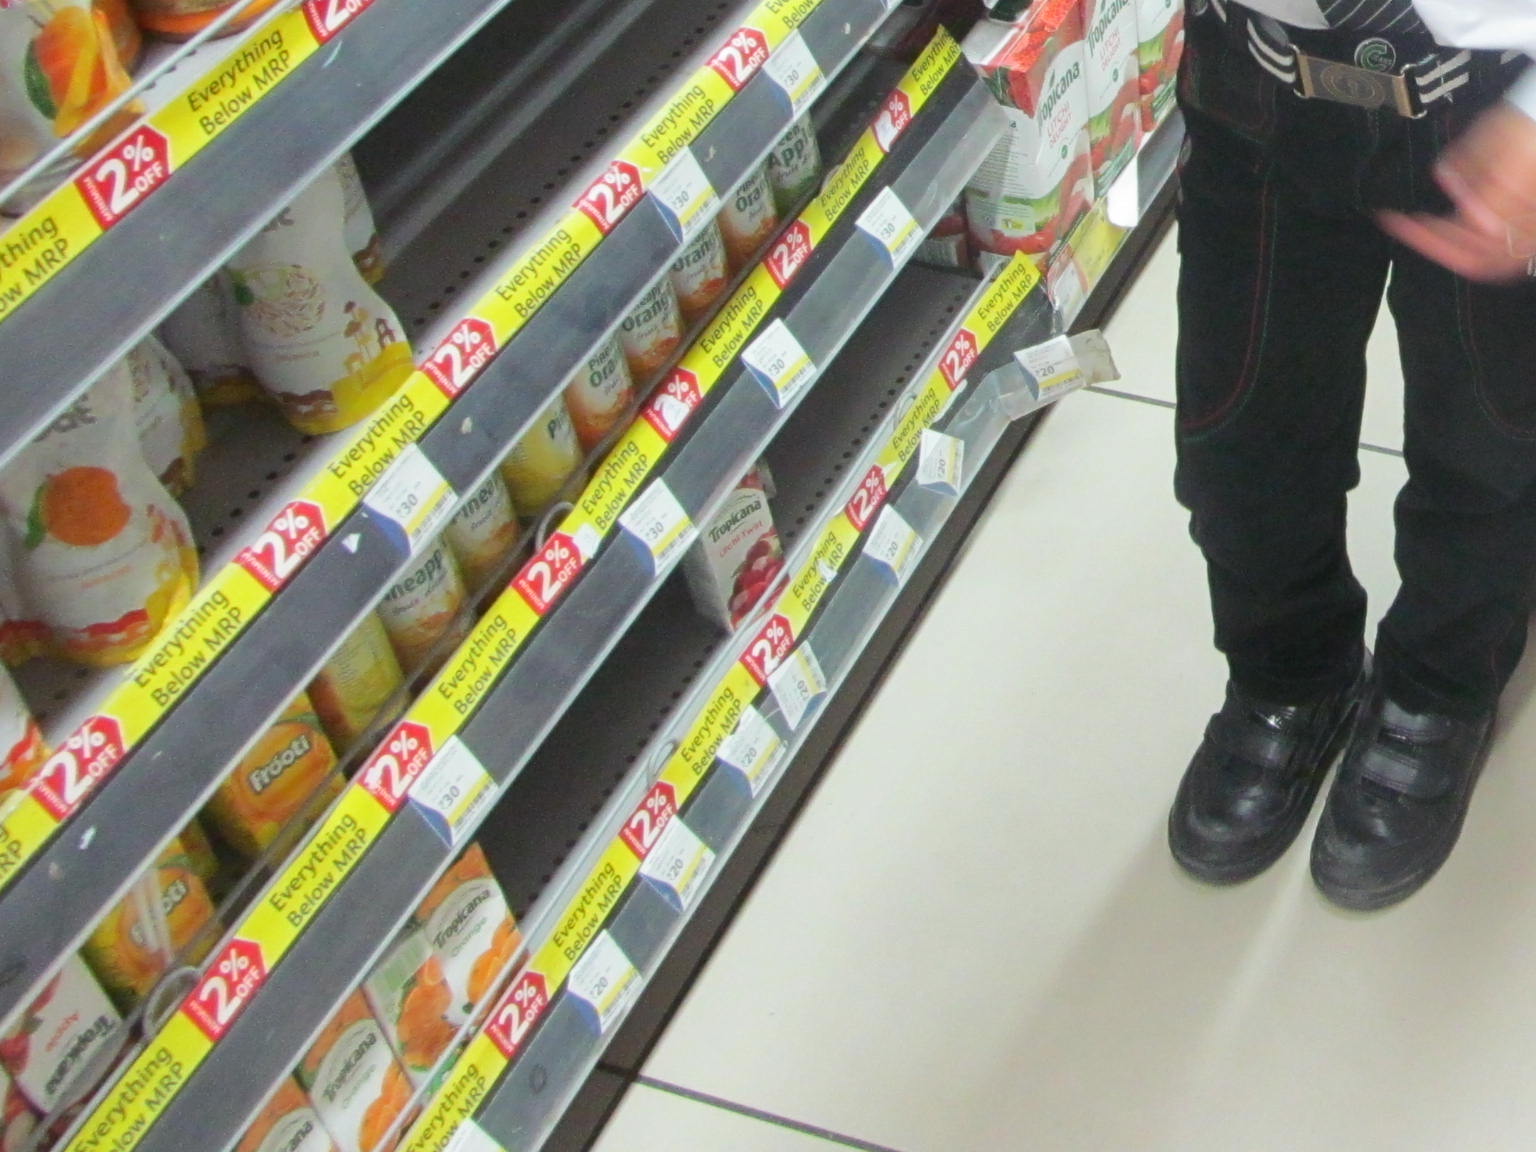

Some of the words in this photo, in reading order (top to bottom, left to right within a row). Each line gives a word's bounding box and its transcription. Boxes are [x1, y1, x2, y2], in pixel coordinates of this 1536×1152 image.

[187, 28, 285, 113] Everything
[748, 45, 767, 71] OFF
[199, 91, 249, 136] Below
[250, 50, 291, 91] MRP
[641, 83, 705, 149] Everything
[656, 129, 690, 167] Below
[690, 100, 716, 133] MRP
[134, 161, 164, 193] OFF
[620, 183, 639, 209] OFF
[820, 147, 865, 208] Everything
[824, 189, 850, 222] Below
[850, 159, 871, 188] MRP
[22, 238, 69, 286] MRP
[495, 227, 570, 302] Everything
[513, 272, 549, 321] Below
[550, 242, 583, 282] MRP
[773, 227, 803, 279] 2%
[793, 243, 809, 265] OFF
[700, 285, 757, 354] Everything
[977, 263, 1026, 320] Everything
[986, 301, 1014, 333] Below
[1013, 273, 1033, 301] MRP
[712, 332, 744, 369] Below
[743, 298, 765, 330] MRP
[946, 334, 970, 383] 2%
[962, 350, 976, 369] OFF
[328, 394, 414, 479] Everything
[892, 387, 936, 450] Everything
[348, 444, 394, 498] Below
[393, 409, 428, 448] MRP
[582, 440, 639, 515] Everything
[596, 489, 624, 531] Below
[623, 454, 649, 490] MRP
[708, 499, 763, 544] Tropicana
[858, 470, 881, 520] 2%
[870, 487, 884, 507] OFF
[297, 530, 322, 557] OFF
[527, 540, 570, 603] 2%
[558, 556, 579, 582] OFF
[792, 531, 836, 599] Everything
[801, 574, 827, 612] Below
[133, 588, 230, 692] Everything
[152, 651, 203, 709] Below
[203, 607, 245, 655] MRP
[438, 613, 508, 701] Everything
[454, 665, 488, 717] Below
[487, 628, 520, 669] MRP
[752, 618, 786, 675] 2%
[775, 637, 794, 661] OFF
[681, 686, 734, 763] Everything
[717, 698, 743, 737] MRP
[89, 747, 118, 781] OFF
[377, 730, 418, 799] 2%
[629, 790, 667, 852] 2%
[655, 804, 674, 829] OFF
[272, 813, 358, 911] Everything
[287, 872, 330, 929] Below
[329, 827, 369, 872] MRP
[433, 889, 493, 949] Tropicana
[552, 861, 616, 949] Everything
[564, 911, 597, 963] Below
[596, 873, 623, 914] MRP
[200, 948, 249, 1025] 2%
[236, 966, 262, 999] OFF
[498, 978, 538, 1047] 2%
[525, 995, 545, 1021] OFF
[145, 1062, 185, 1113] MRP
[323, 1030, 378, 1105] Tropicana
[458, 1074, 488, 1118] MRP
